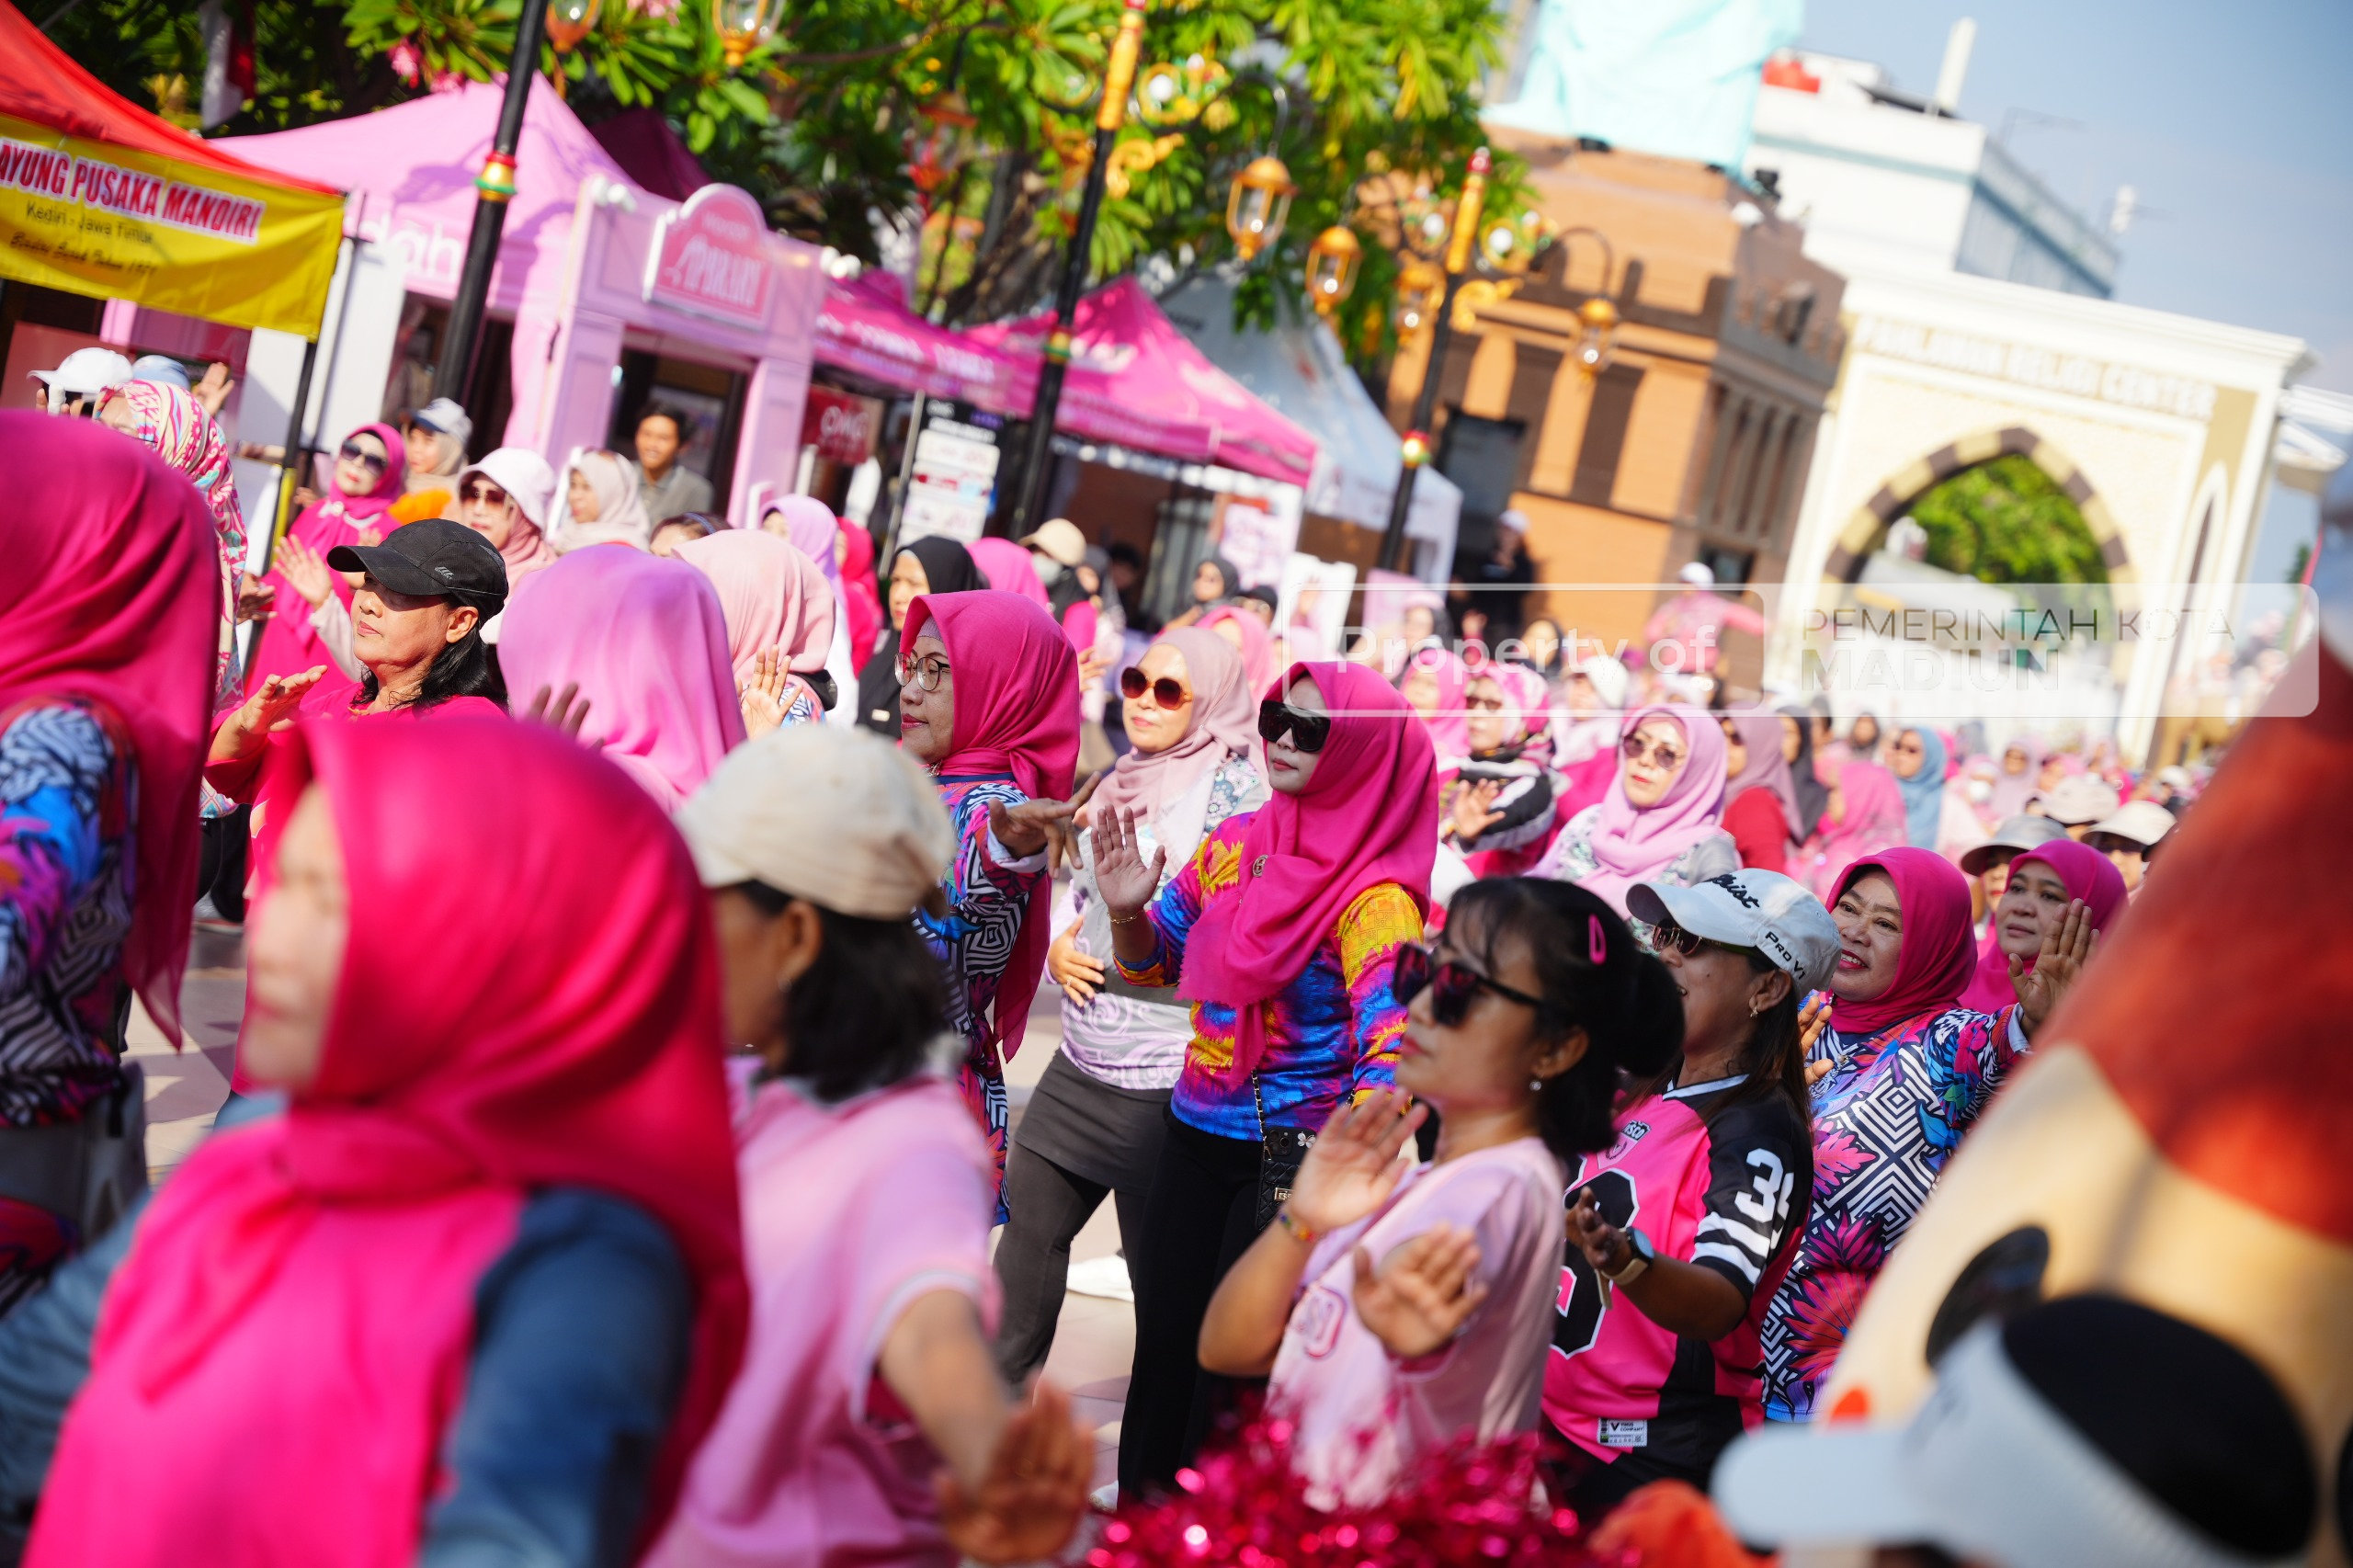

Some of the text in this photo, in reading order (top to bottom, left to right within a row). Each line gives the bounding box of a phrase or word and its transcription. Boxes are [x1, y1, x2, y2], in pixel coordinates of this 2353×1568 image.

[70, 159, 162, 216] PUSAKA
[162, 185, 264, 239] MANDIRI
[27, 201, 67, 226] Kediri
[78, 212, 112, 235] Jawa
[1765, 931, 1792, 961] PRO
